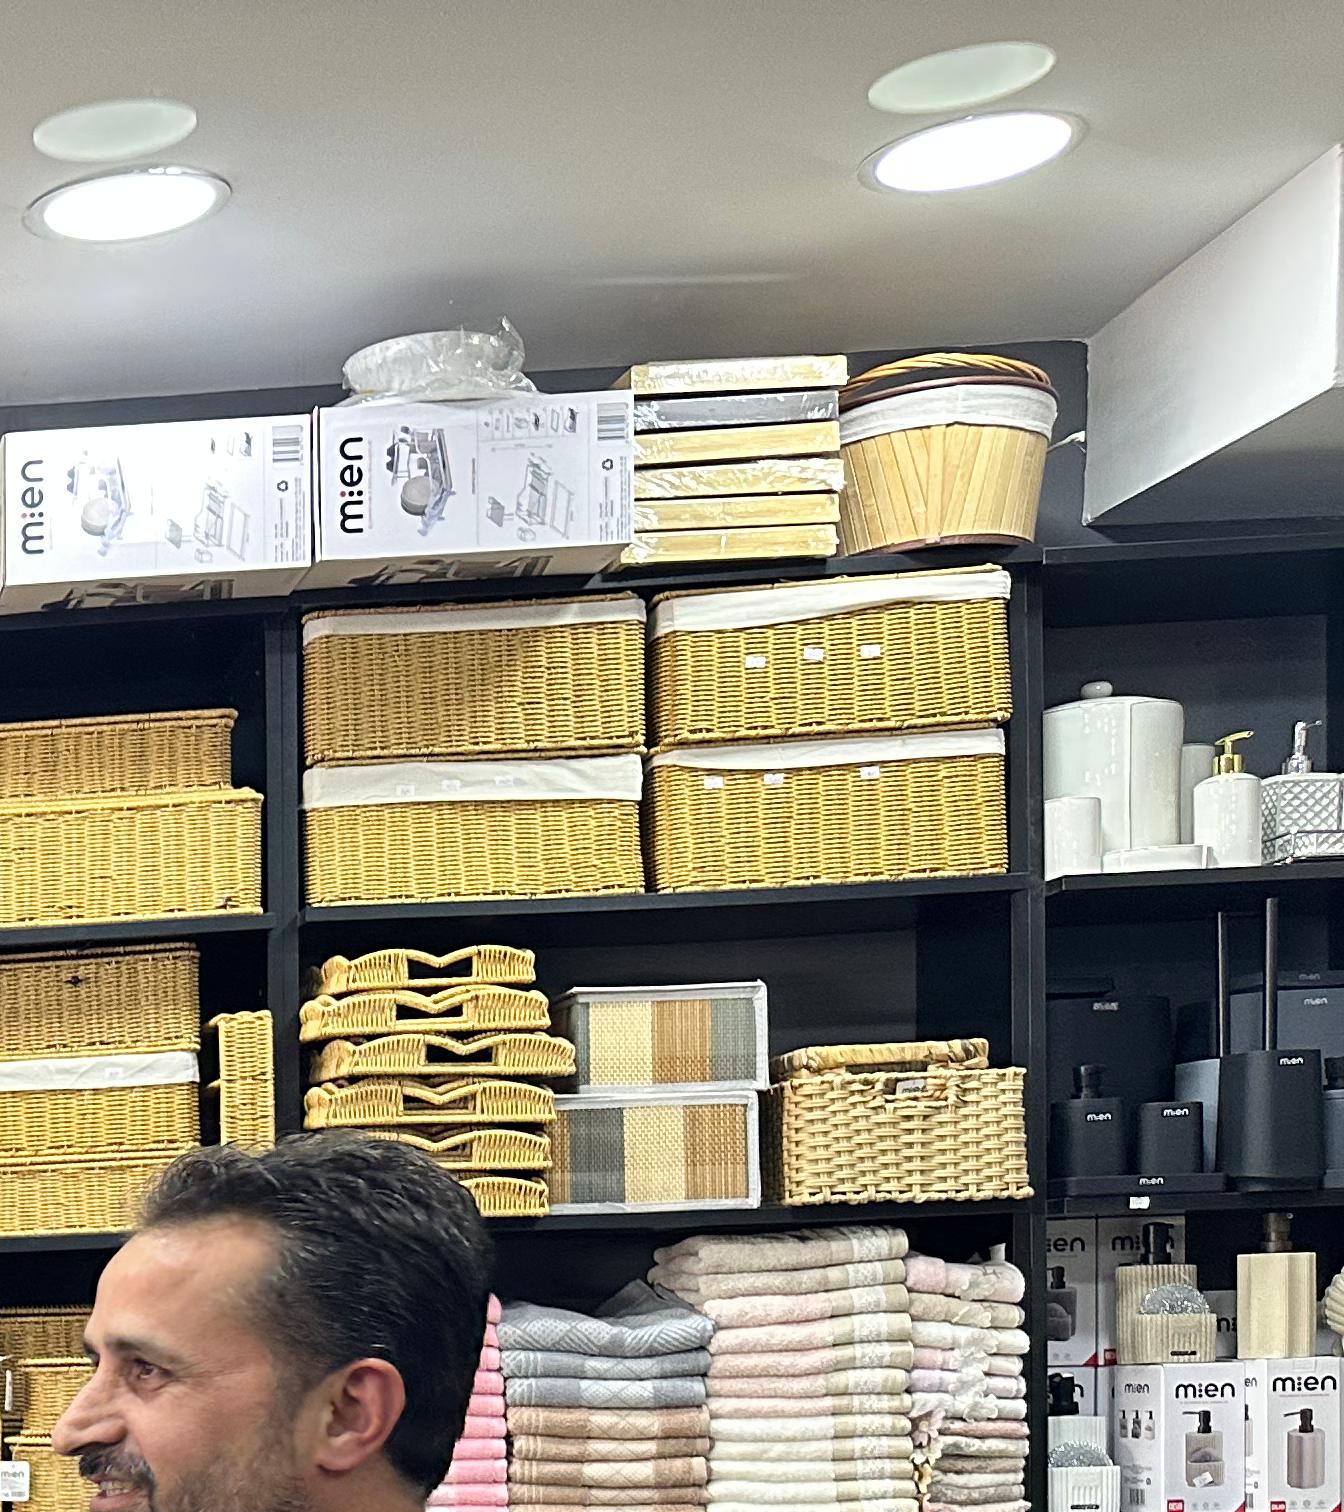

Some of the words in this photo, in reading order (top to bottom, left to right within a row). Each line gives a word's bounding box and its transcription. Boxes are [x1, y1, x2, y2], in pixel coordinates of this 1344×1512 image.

[339, 436, 364, 534] mien
[20, 459, 44, 554] mien
[1086, 1113, 1112, 1121] mien
[1163, 1108, 1189, 1117] mien
[1139, 1177, 1164, 1186] mien
[1046, 1236, 1086, 1252] ien
[1124, 1383, 1150, 1395] mien
[1175, 1382, 1236, 1398] mien
[1272, 1375, 1337, 1392] mien
